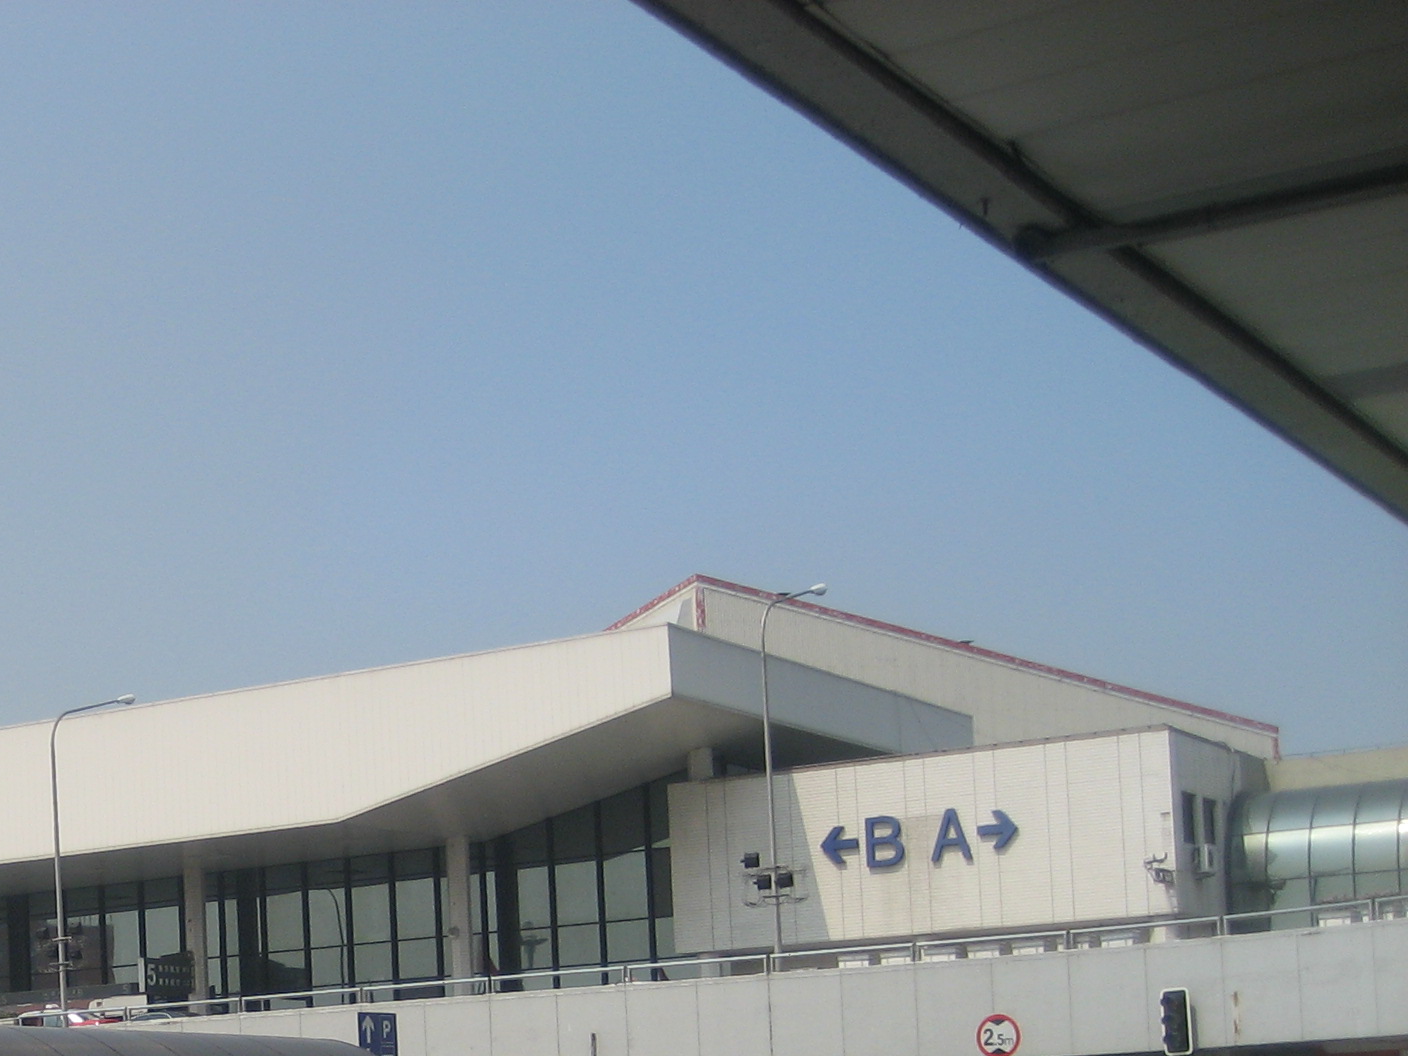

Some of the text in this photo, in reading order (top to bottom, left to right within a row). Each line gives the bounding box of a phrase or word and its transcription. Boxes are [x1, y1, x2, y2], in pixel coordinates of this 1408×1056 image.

[865, 808, 973, 867] B A
[382, 1020, 391, 1038] P
[983, 1028, 1014, 1046] 2.5m
